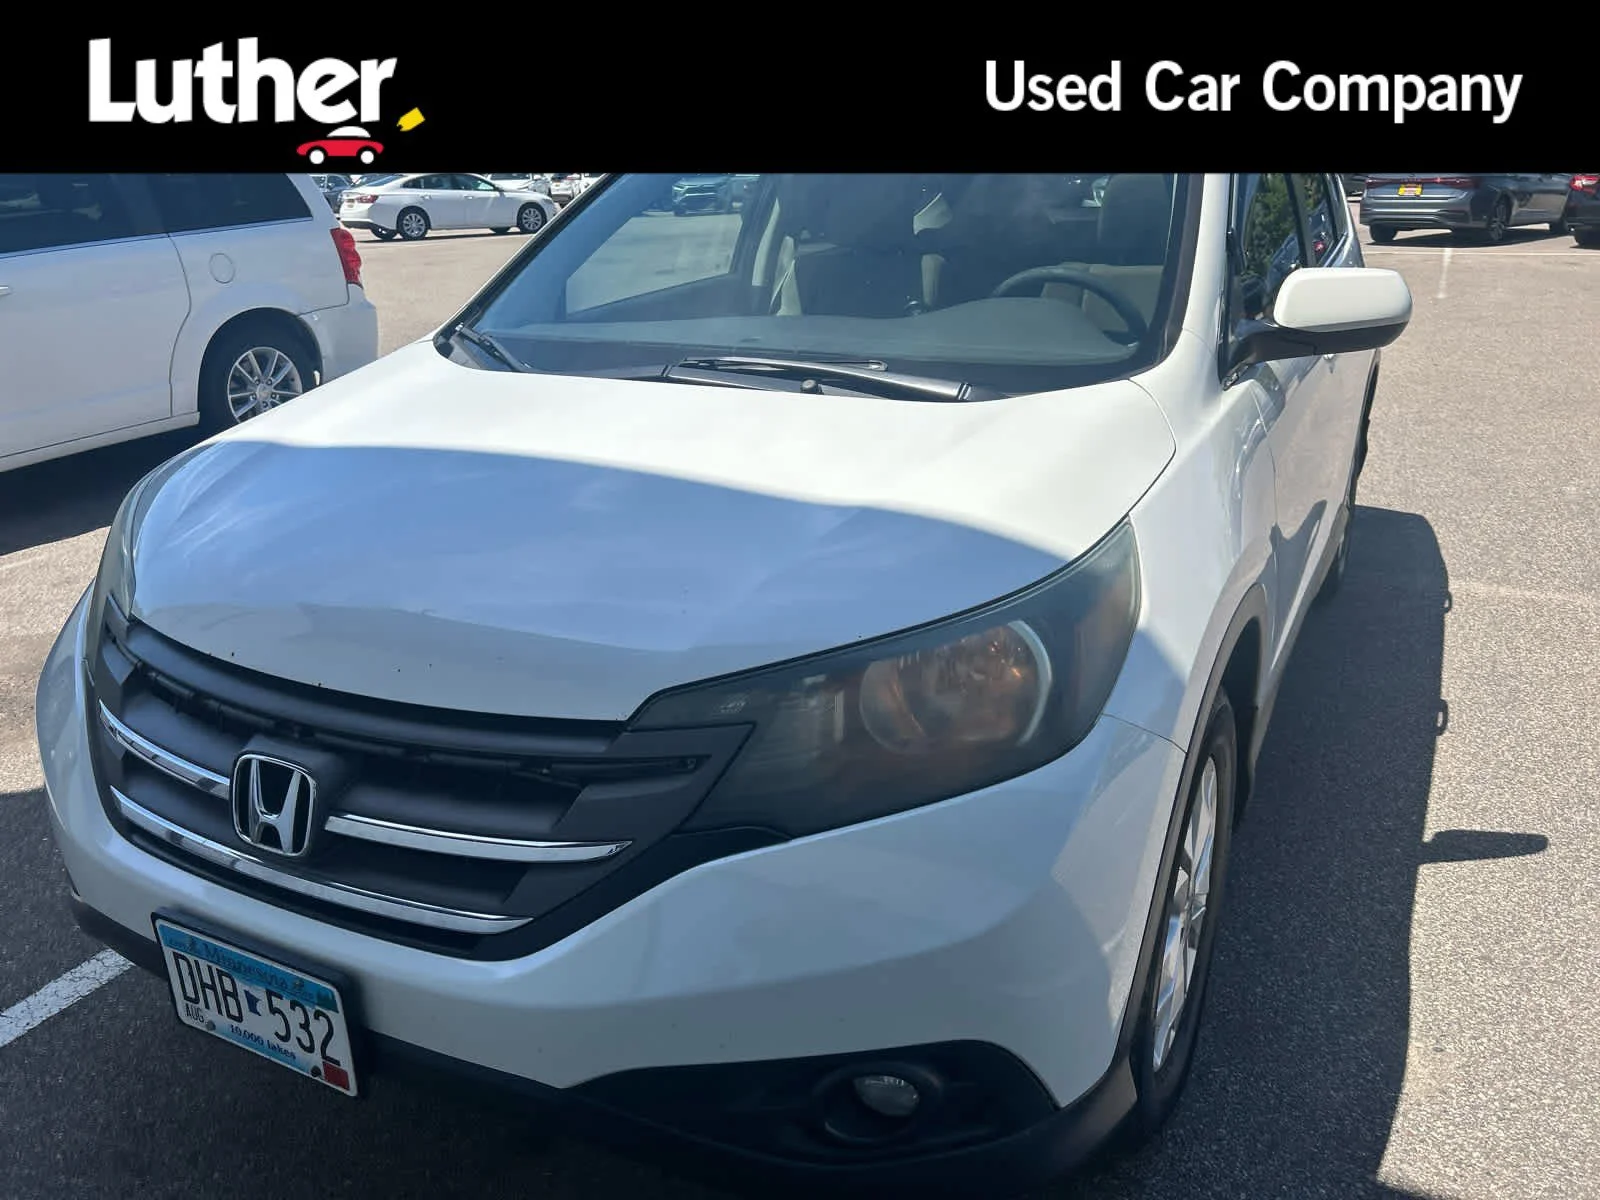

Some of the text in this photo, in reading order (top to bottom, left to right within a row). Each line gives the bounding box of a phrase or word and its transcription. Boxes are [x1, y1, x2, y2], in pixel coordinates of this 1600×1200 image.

[172, 951, 341, 1067] DHB 532
[266, 1039, 297, 1061] lakes
